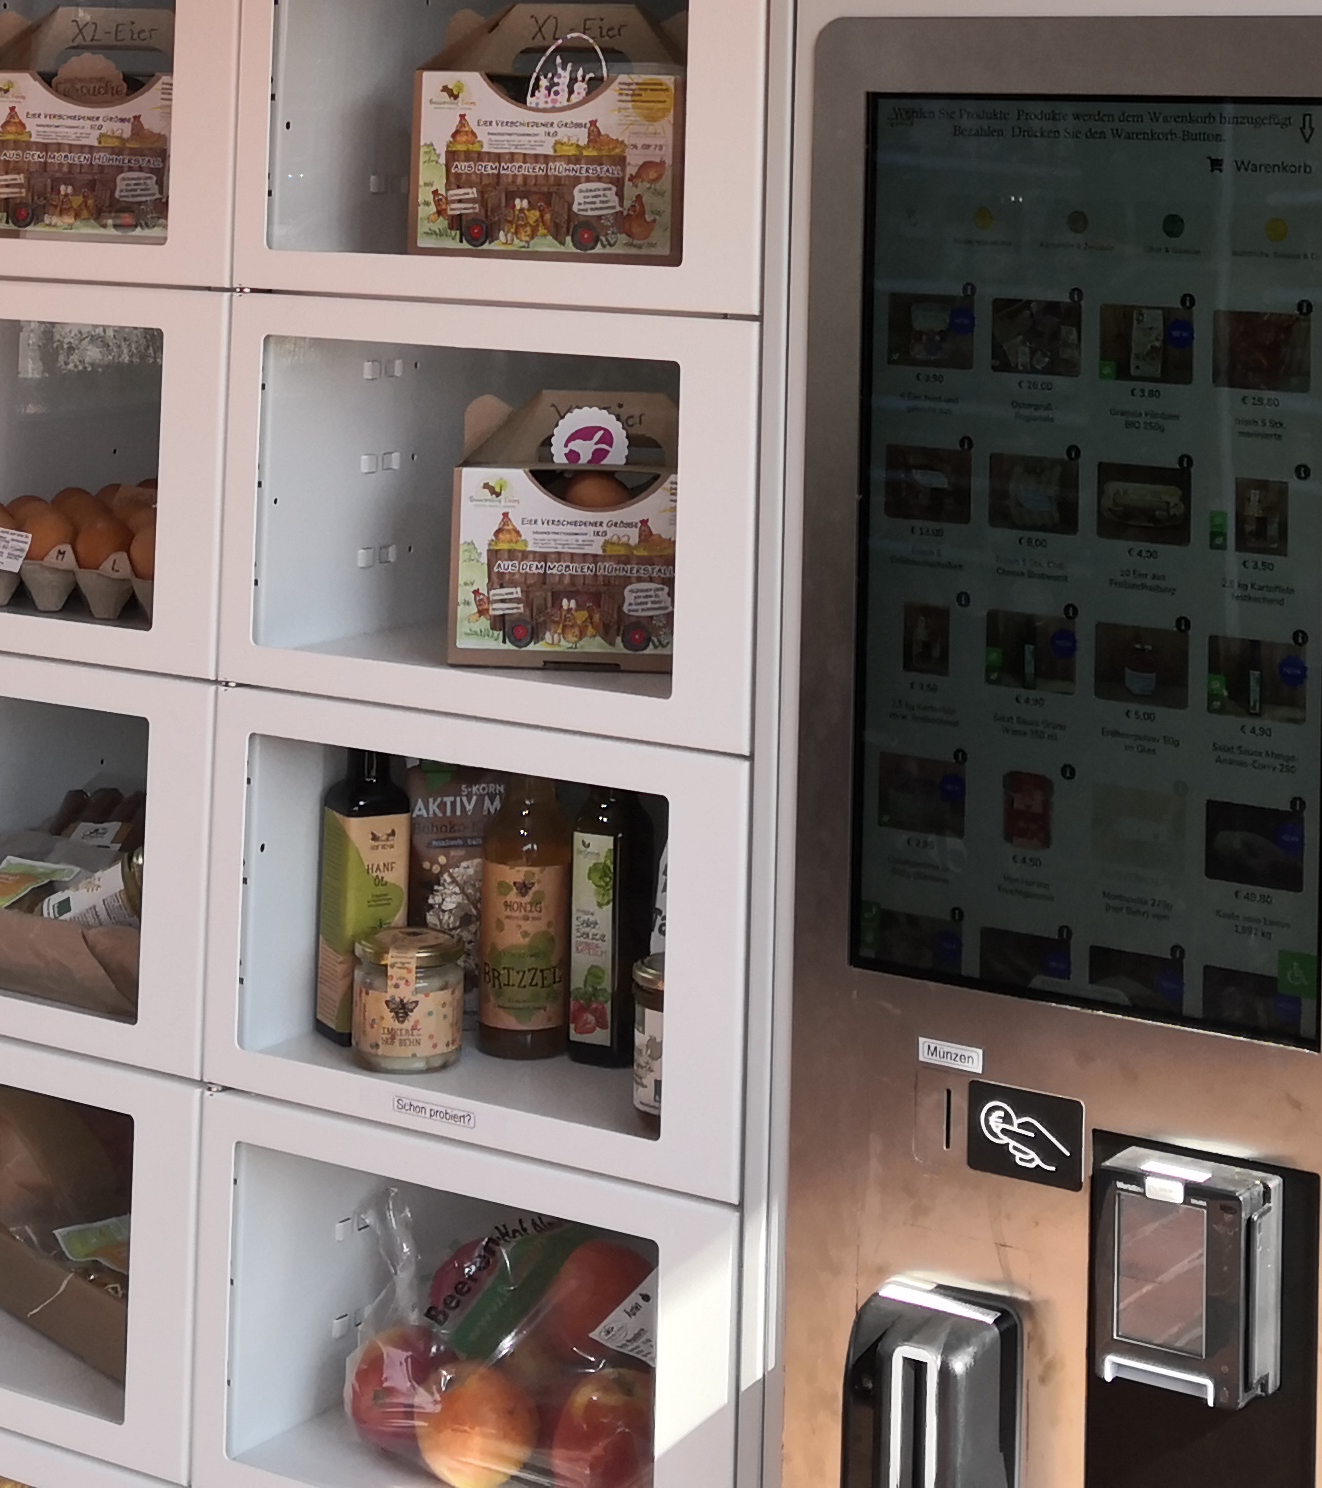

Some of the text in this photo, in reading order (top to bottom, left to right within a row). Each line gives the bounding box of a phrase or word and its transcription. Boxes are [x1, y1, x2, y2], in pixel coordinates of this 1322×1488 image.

[1234, 159, 1313, 176] Warenkorb
[55, 548, 66, 562] M
[111, 559, 120, 573] L
[412, 795, 477, 818] AKTIV
[366, 861, 397, 875] HANF
[503, 900, 543, 914] HONIG
[483, 961, 562, 990] BRIZZEL
[926, 1043, 975, 1066] Münzen
[396, 1098, 427, 1116] Schon
